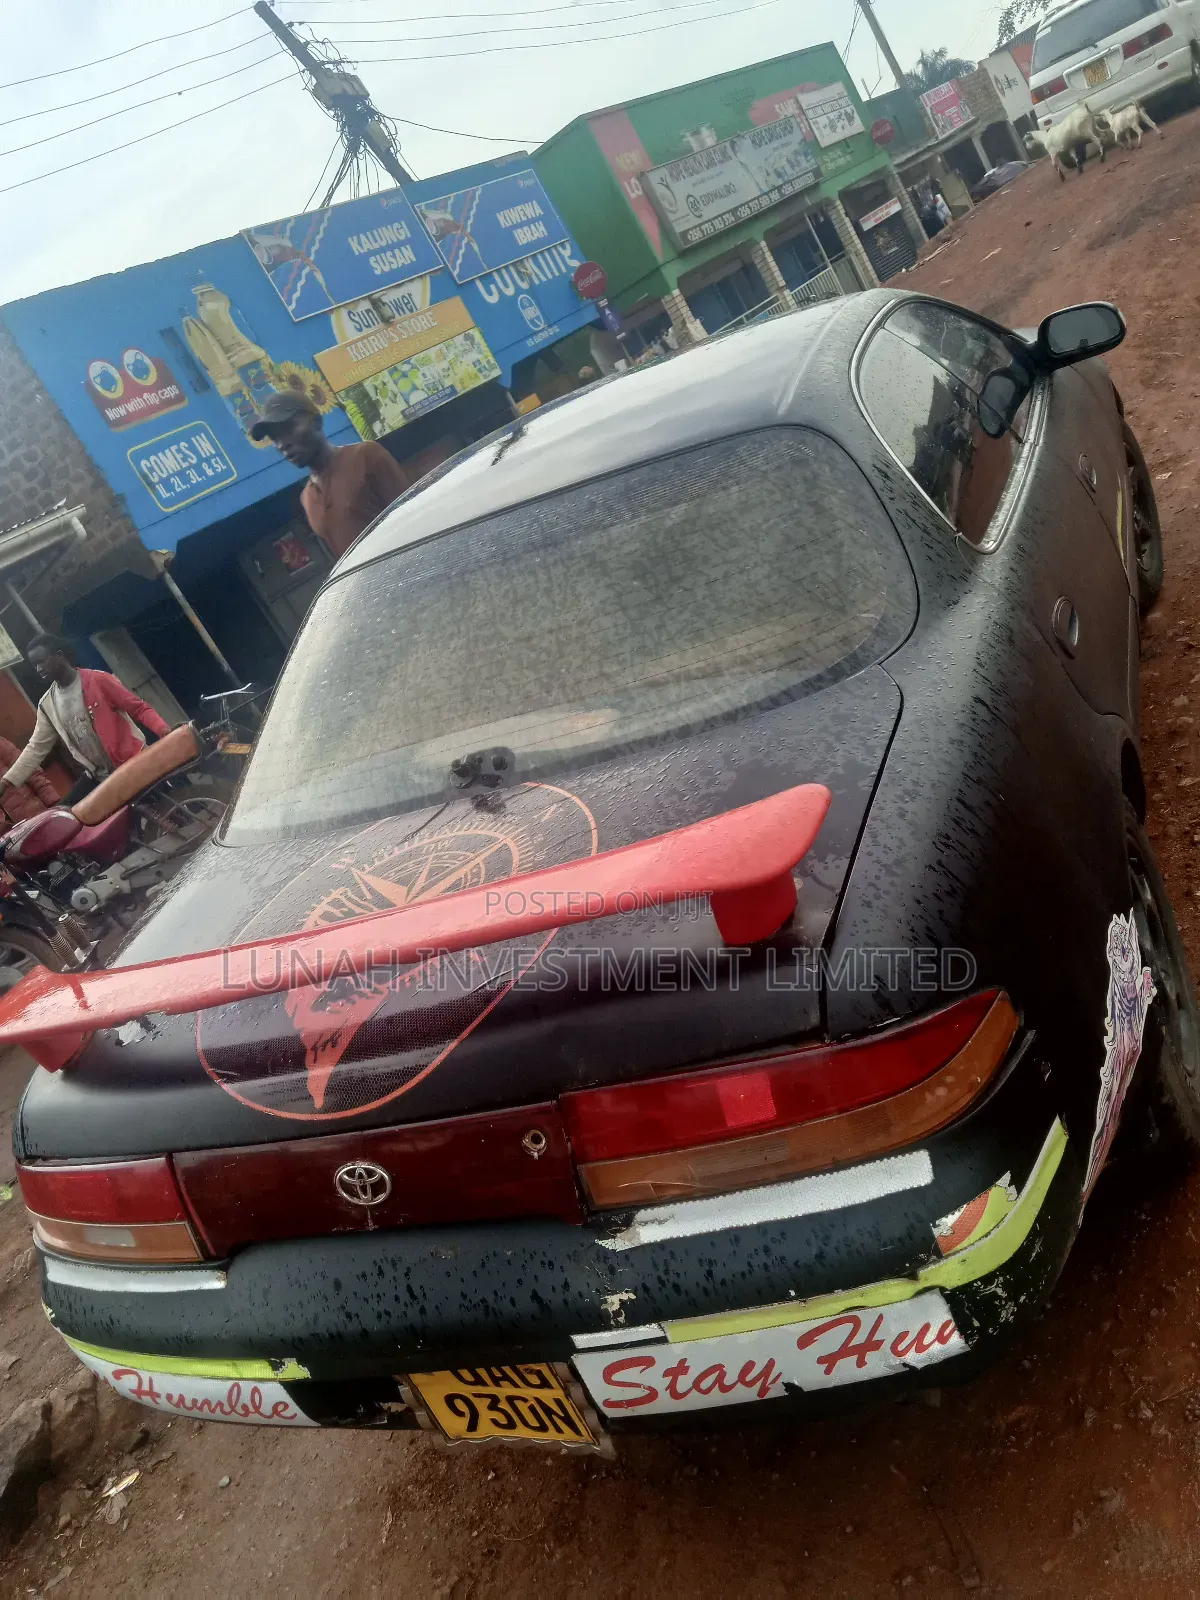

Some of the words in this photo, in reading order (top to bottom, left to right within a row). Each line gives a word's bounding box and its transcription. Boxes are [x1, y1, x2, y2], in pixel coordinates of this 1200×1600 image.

[496, 200, 544, 228] KIWEWA
[347, 220, 412, 255] KALUNGI
[512, 221, 548, 246] IBRAH
[369, 245, 417, 275] SUSAN
[395, 308, 438, 340] STORE
[105, 403, 126, 420] Now
[125, 395, 146, 413] with
[143, 391, 160, 406] flip
[158, 384, 179, 400] caps
[140, 441, 198, 483] COMES
[191, 433, 216, 459] IN
[170, 475, 190, 493] 2L,
[186, 467, 206, 484] 3L,
[202, 462, 215, 476] &
[211, 456, 227, 472] 5L
[112, 1368, 298, 1420] Humble
[602, 1355, 783, 1410] Stay
